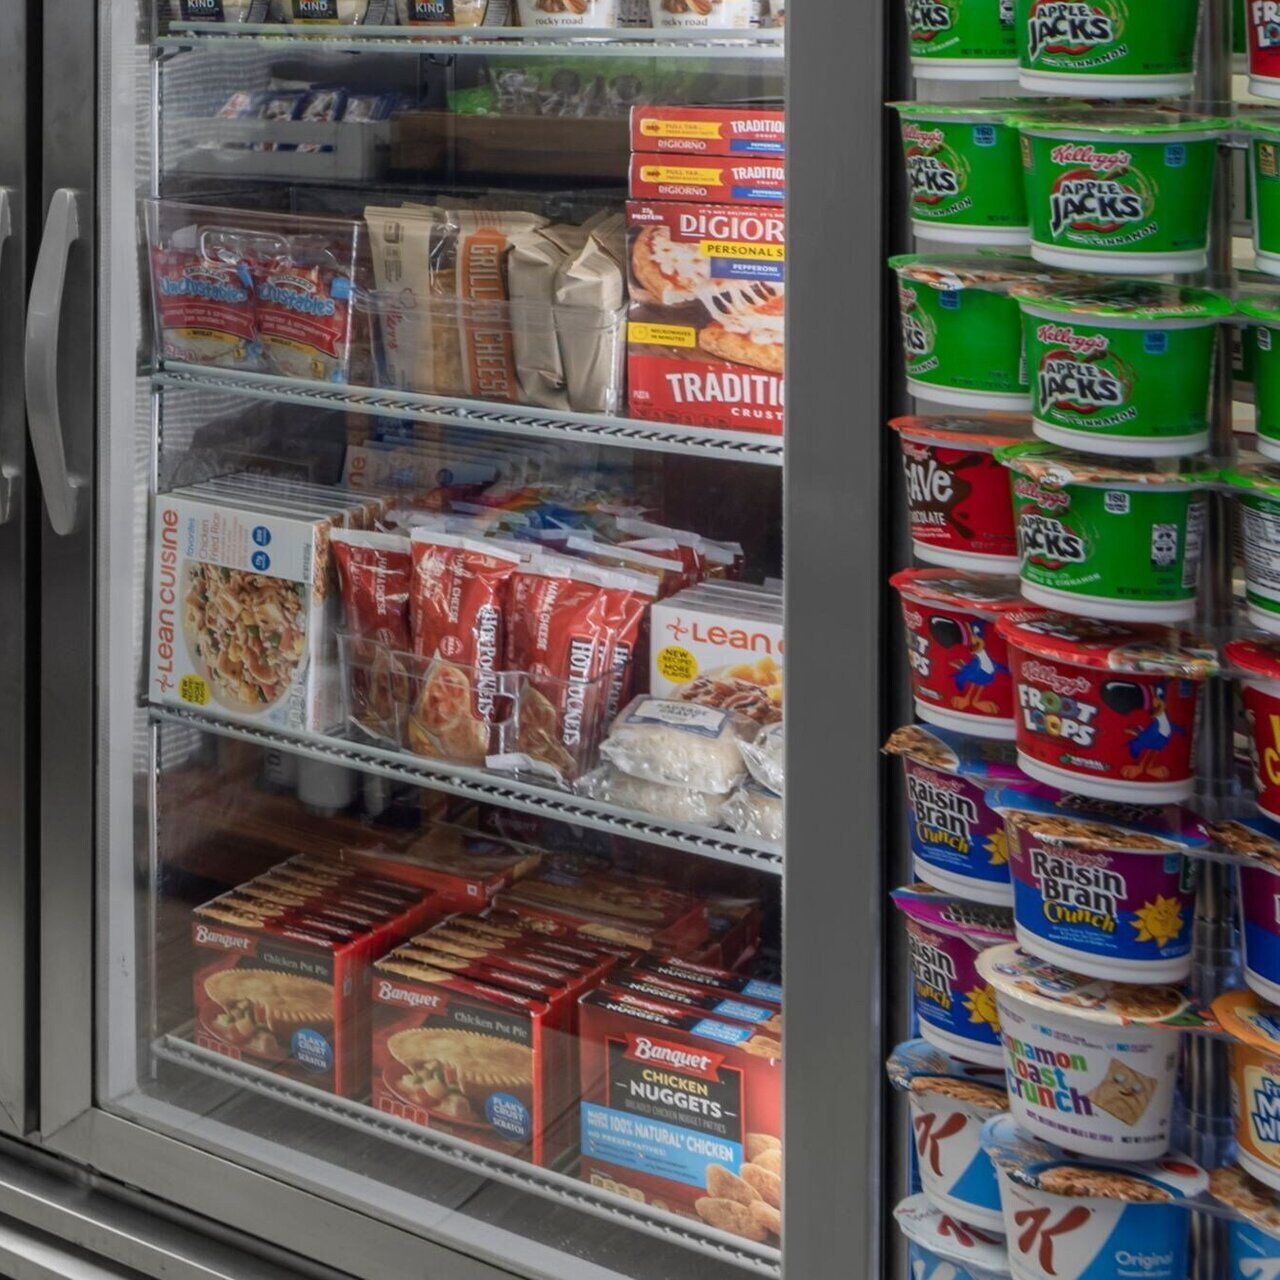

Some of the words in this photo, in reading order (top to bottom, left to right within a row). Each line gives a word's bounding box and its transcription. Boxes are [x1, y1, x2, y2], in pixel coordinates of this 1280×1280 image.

[187, 0, 214, 9] KIND
[299, 0, 328, 11] KIND
[415, 3, 444, 14] KIND
[1038, 4, 1087, 17] APPLE
[563, 16, 583, 25] road
[689, 17, 708, 26] road
[1029, 19, 1113, 61] JACKS
[1051, 145, 1131, 168] Kellogg's
[1061, 181, 1120, 196] APPLE
[1050, 193, 1142, 237] JACKS
[1094, 223, 1158, 247] CINNAMON
[708, 244, 772, 256] PERSONAL
[1038, 324, 1108, 352] Kellogg's
[1046, 361, 1099, 377] APPLE
[1040, 373, 1122, 409] JACKS
[731, 407, 784, 420] CRUST
[1077, 408, 1137, 427] CINNAMON
[158, 610, 175, 673] Lean
[536, 609, 552, 651] CHEESE
[692, 623, 771, 654] Lean
[666, 649, 688, 658] NEW
[1018, 683, 1097, 723] FROOT
[1023, 709, 1095, 746] LOOPS
[909, 778, 975, 821] Raisin
[916, 801, 970, 841] Bran
[917, 823, 969, 854] Crunch
[1032, 850, 1123, 896] Raisin
[1044, 878, 1116, 916] Bran
[1043, 900, 1116, 933] Crunch
[196, 926, 251, 950] Banquet
[379, 982, 440, 1008] Banquet
[493, 1022, 511, 1033] Pot
[512, 1025, 527, 1037] Pie
[634, 1037, 712, 1070] Banquet
[643, 1070, 708, 1096] CHICKEN
[630, 1080, 722, 1118] NUGGETS
[610, 1115, 633, 1134] 100%
[686, 1137, 734, 1161] CHICKEN
[914, 1111, 968, 1176] K
[1014, 1204, 1092, 1276] K
[1115, 1250, 1173, 1267] Original
